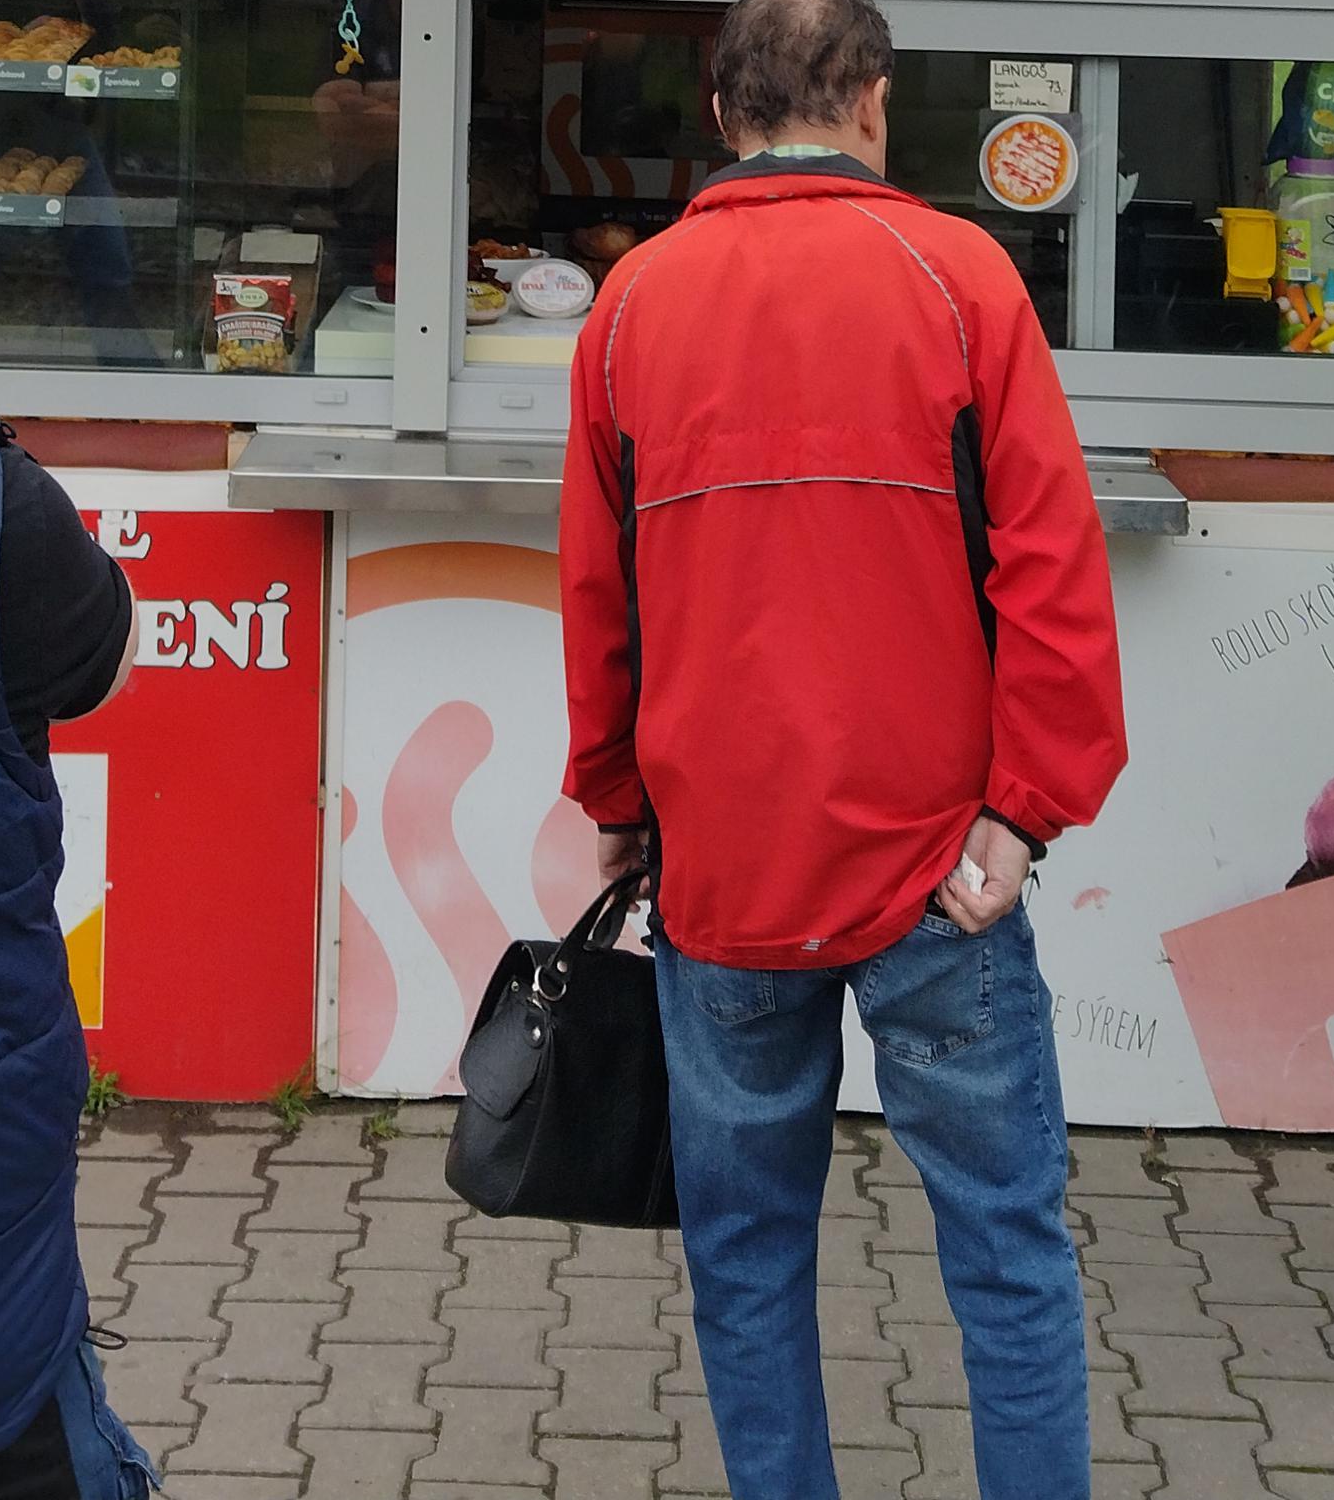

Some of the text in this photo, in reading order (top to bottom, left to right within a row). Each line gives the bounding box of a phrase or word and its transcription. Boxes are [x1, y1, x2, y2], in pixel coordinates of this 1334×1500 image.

[994, 62, 1047, 79] LANGOŠ
[1211, 609, 1290, 673] ROLLO
[1070, 995, 1157, 1058] SÝREM
